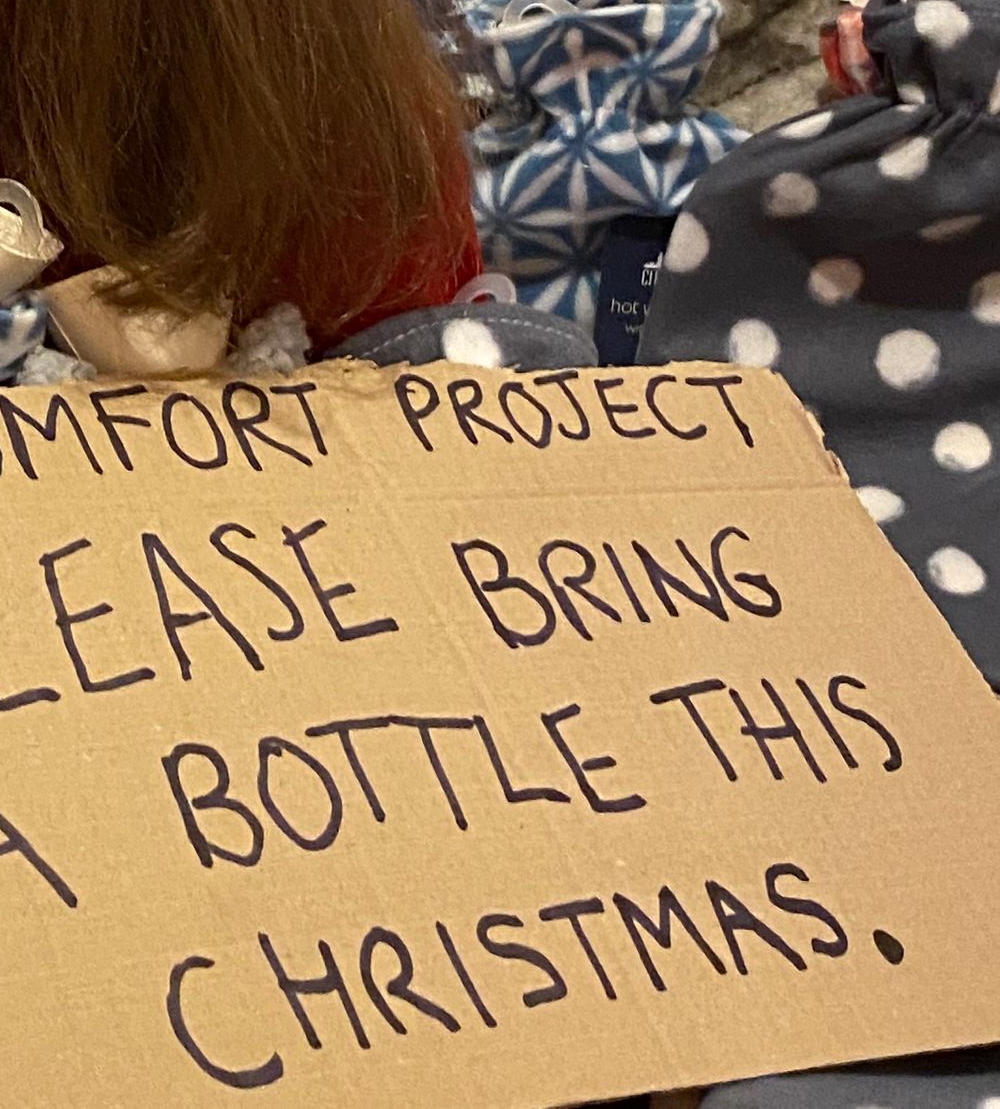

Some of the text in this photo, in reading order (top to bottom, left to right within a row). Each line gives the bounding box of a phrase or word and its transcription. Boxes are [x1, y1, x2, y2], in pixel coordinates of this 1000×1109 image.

[610, 297, 639, 315] hot
[393, 373, 754, 452] PROJECT
[451, 526, 782, 650] BRING
[161, 703, 648, 869] BOTTLE
[650, 675, 903, 784] THIS
[166, 863, 905, 1090] CHRISTMAS.
